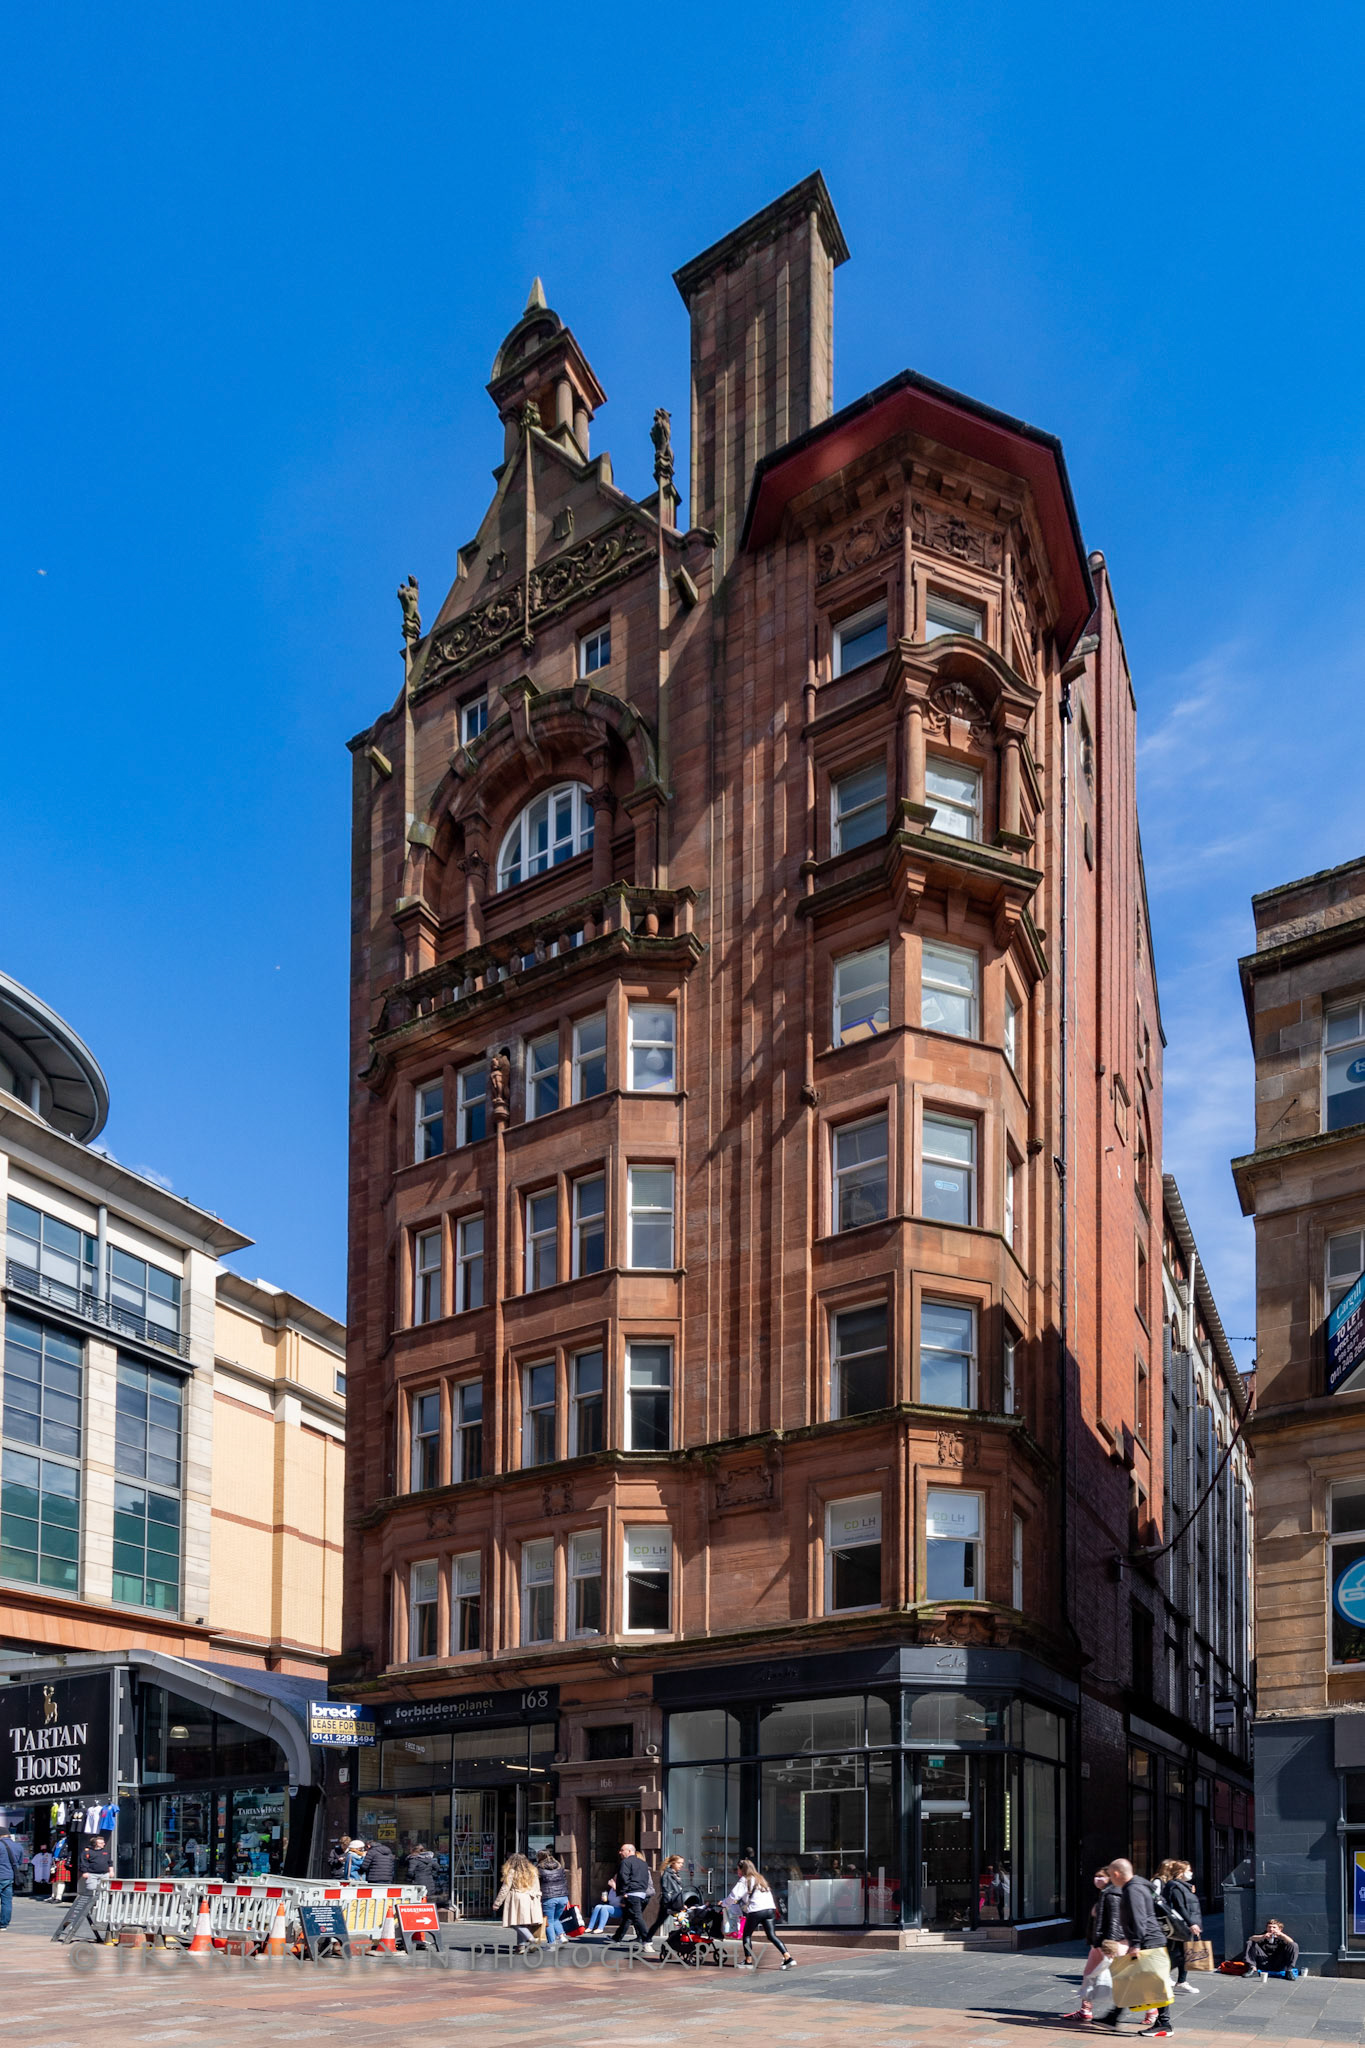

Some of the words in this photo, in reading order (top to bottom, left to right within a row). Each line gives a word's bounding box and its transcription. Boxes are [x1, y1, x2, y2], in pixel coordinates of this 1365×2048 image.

[1336, 1280, 1361, 1319] Cargill
[1336, 1326, 1345, 1342] TO
[1347, 1307, 1360, 1331] LET
[862, 1516, 876, 1527] LH
[951, 1513, 965, 1523] LH
[633, 1546, 649, 1555] CD
[652, 1546, 667, 1554] LH
[521, 1690, 549, 1710] 168
[311, 1702, 357, 1719] breck
[312, 1720, 337, 1730] LEASE
[339, 1721, 354, 1731] FOR
[356, 1722, 374, 1732] SALE
[9, 1723, 89, 1753] TARTAN
[336, 1734, 352, 1742] 229
[15, 1754, 81, 1781] HOUSE
[15, 1786, 28, 1797] OF
[30, 1781, 81, 1795] SCOTLAND
[237, 1807, 261, 1816] TARTAN
